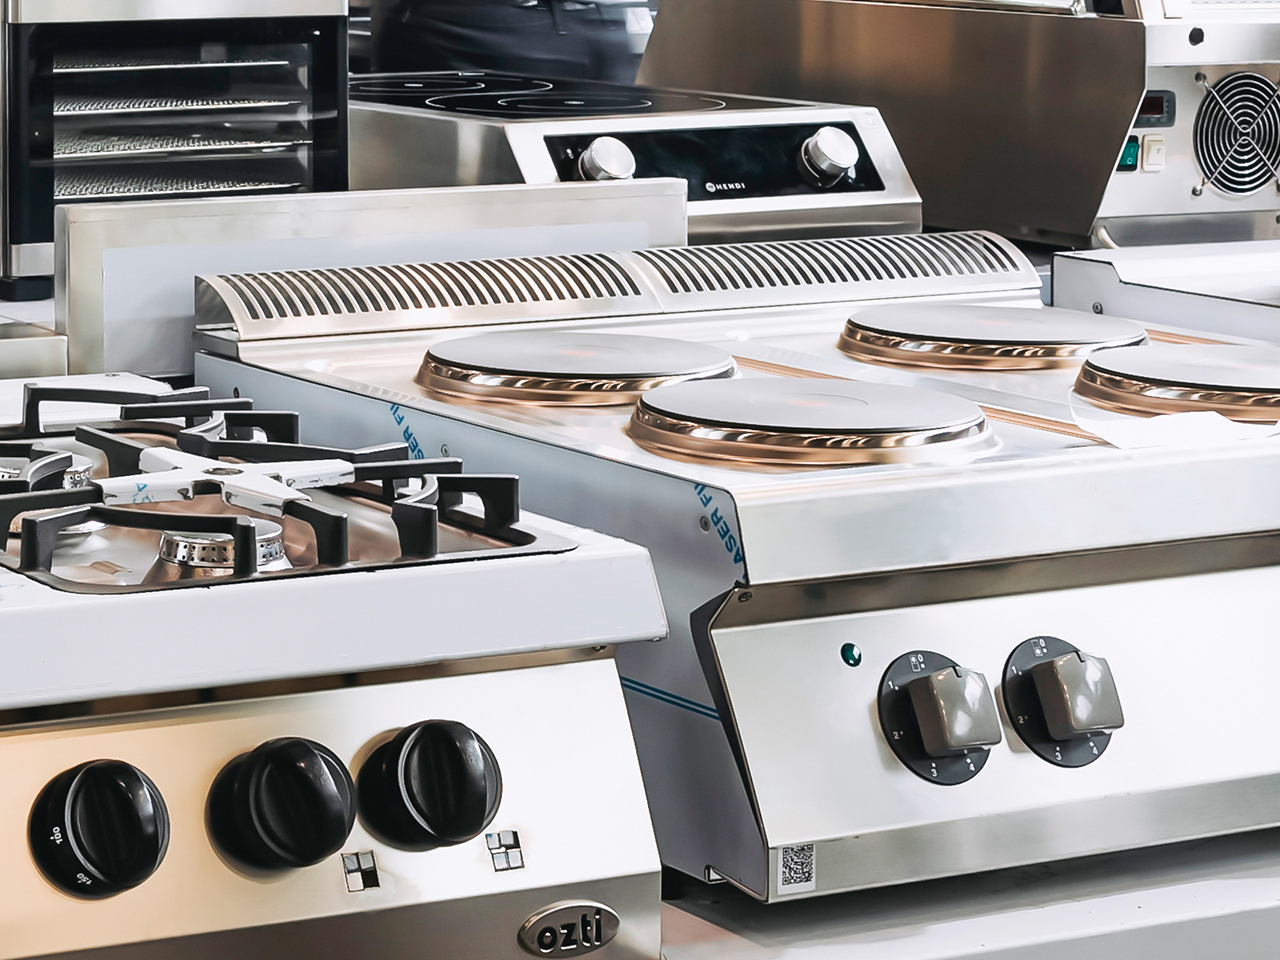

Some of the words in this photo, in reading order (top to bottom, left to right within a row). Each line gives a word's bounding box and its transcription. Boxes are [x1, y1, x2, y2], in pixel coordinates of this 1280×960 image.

[715, 182, 746, 190] HENDI
[710, 506, 746, 580] ASER
[52, 826, 64, 845] 100
[76, 872, 93, 885] 150
[537, 908, 602, 953] ozti
